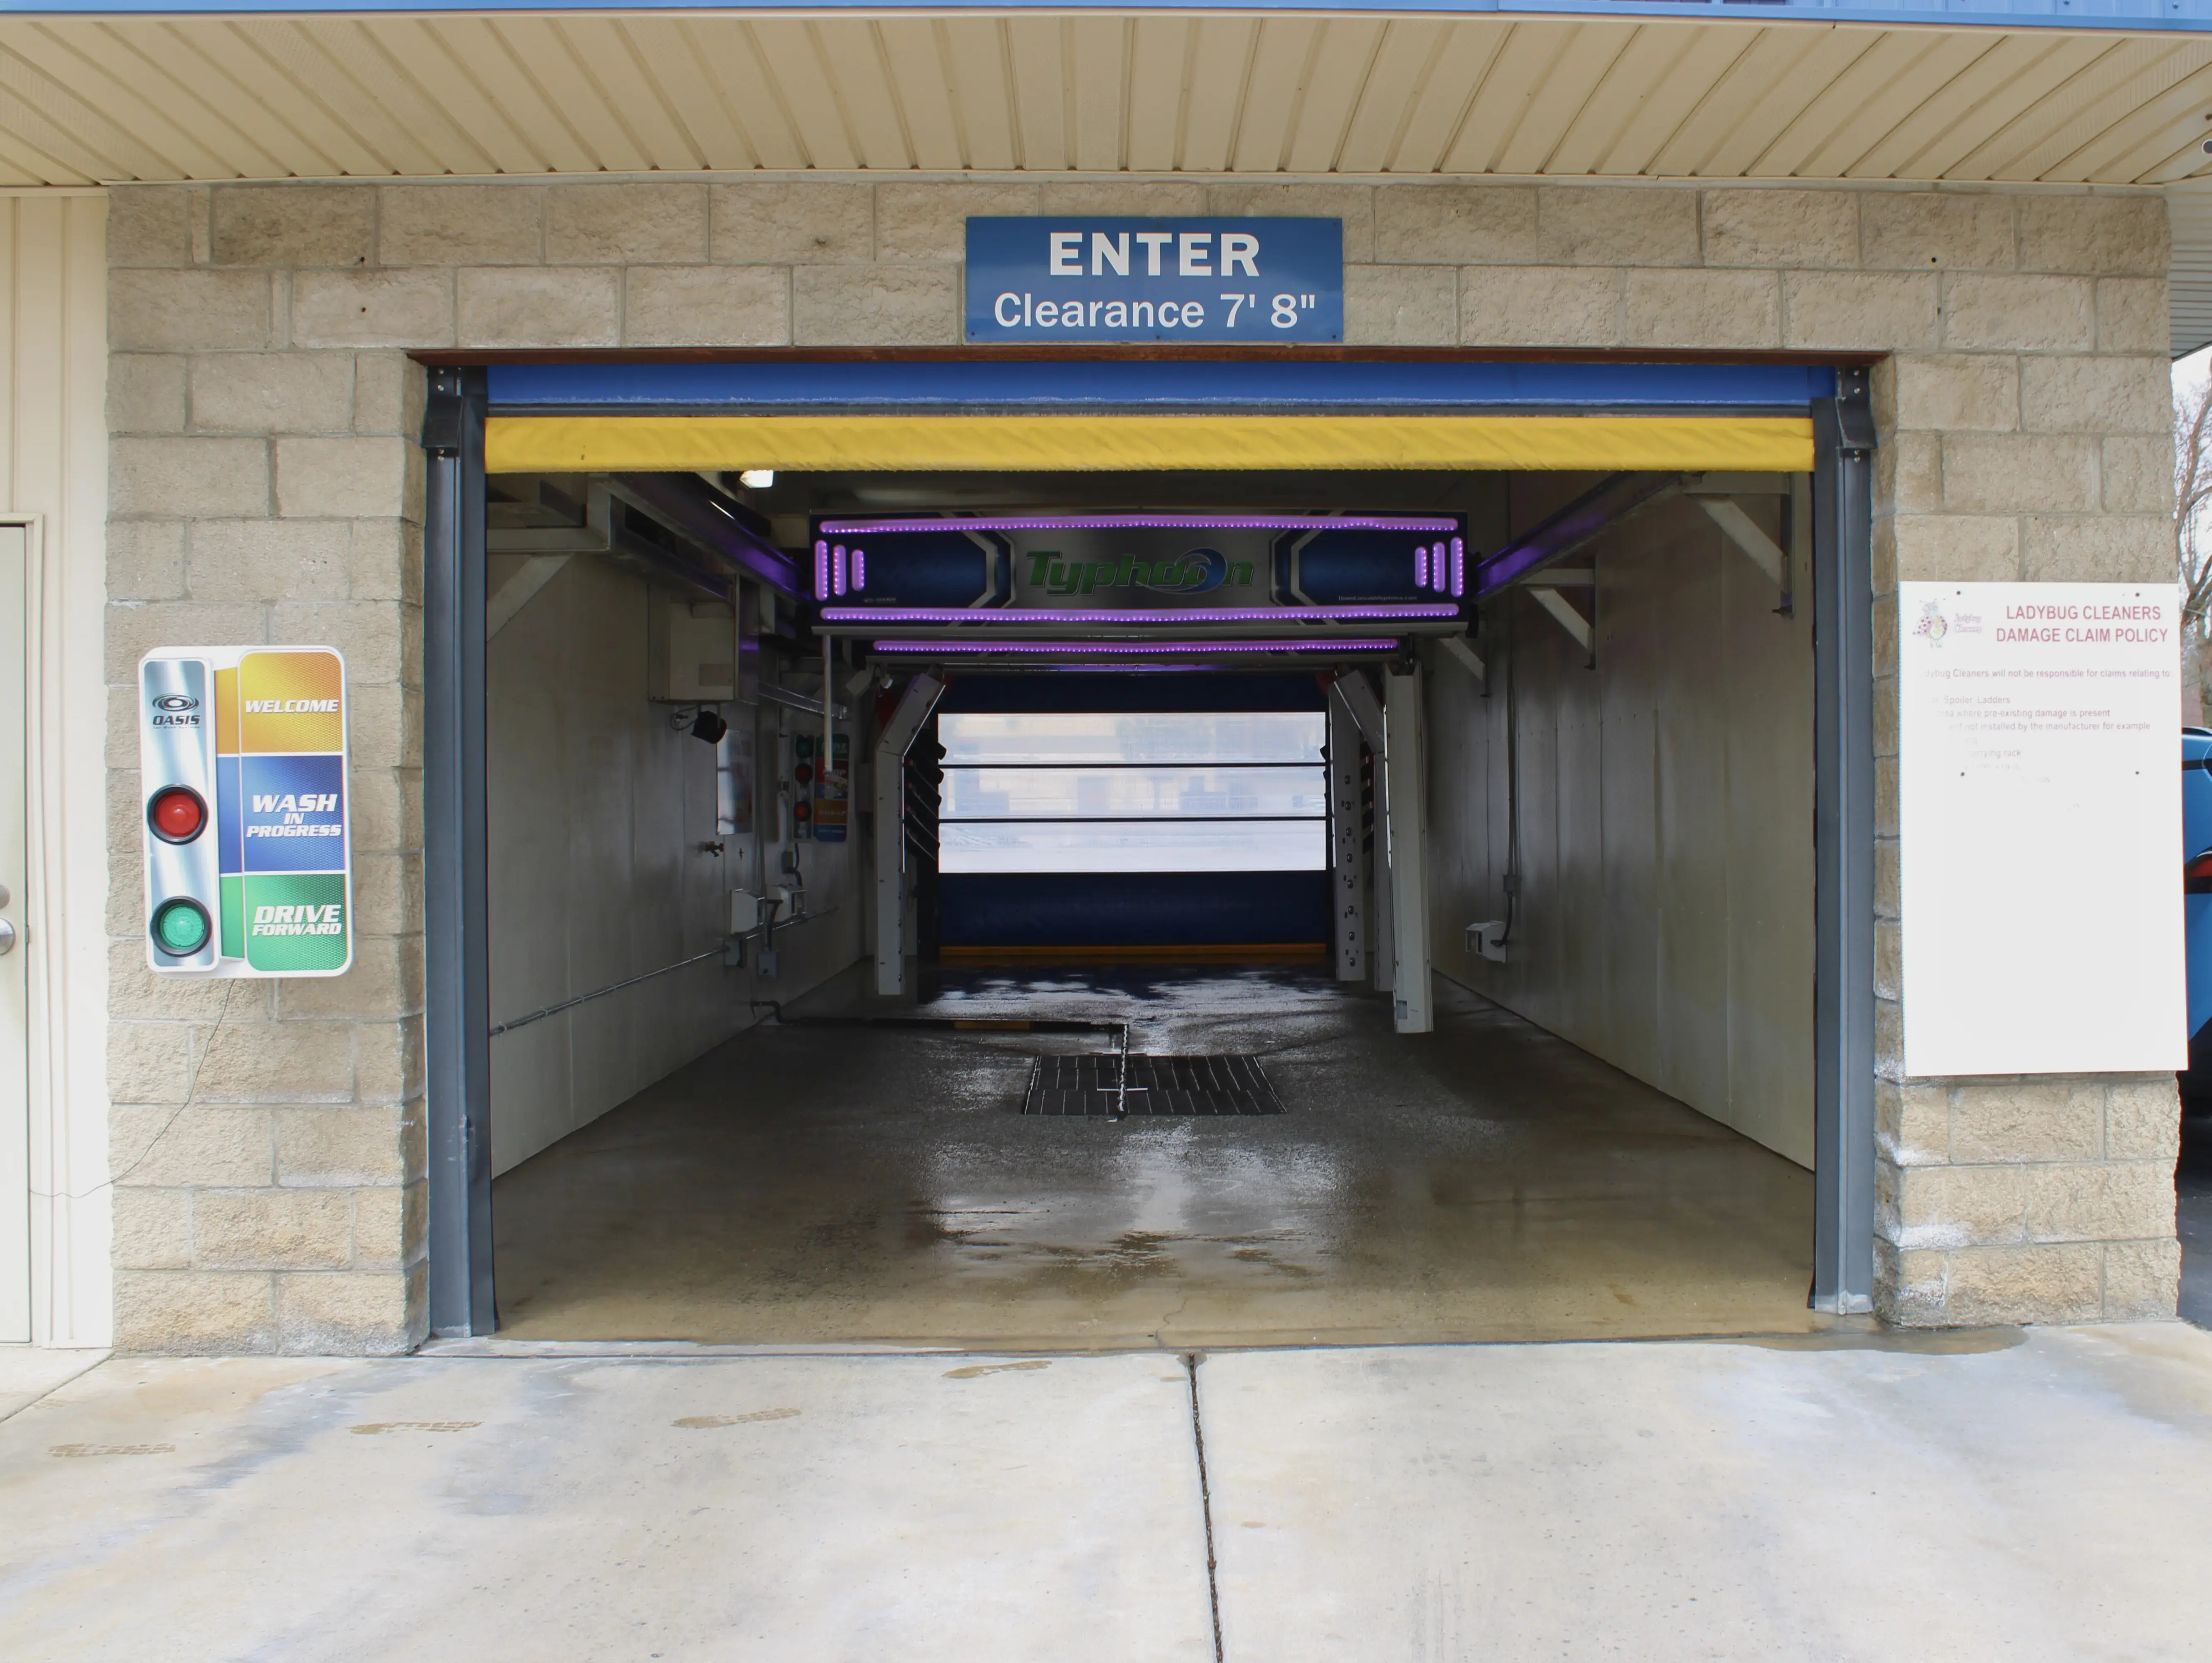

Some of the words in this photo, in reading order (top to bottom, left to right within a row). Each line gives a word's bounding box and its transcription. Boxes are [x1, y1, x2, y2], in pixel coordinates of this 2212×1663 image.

[1050, 232, 1260, 276] ENTER
[995, 293, 1204, 327] Clearance
[1220, 293, 1256, 328] 7'
[1271, 294, 1316, 328] 8"
[1026, 547, 1255, 597] Typhoon
[2006, 605, 2078, 620] LADYBUG
[2083, 606, 2161, 620] CLEANERS
[1996, 628, 2061, 642] DAMAGE
[2065, 628, 2110, 642] CLAIM
[2115, 628, 2168, 642] POLICY
[1953, 668, 1989, 677] Cleaners
[1992, 669, 2005, 677] will
[2024, 669, 2033, 677] be
[2036, 669, 2084, 679] responsible
[2100, 669, 2126, 677] claims
[2129, 669, 2160, 679] relating
[1977, 695, 2011, 704] Ladders
[246, 699, 339, 714] WELCOME
[153, 715, 201, 725] OASIS
[1957, 709, 1981, 717] where
[1984, 708, 2033, 719] pre-existing
[2035, 709, 2068, 719] damage
[2079, 709, 2110, 718] present
[1981, 722, 2015, 730] installed
[2018, 722, 2027, 732] by
[2046, 721, 2100, 730] manufacturer
[2103, 721, 2114, 730] for
[2116, 721, 2151, 731] example
[253, 793, 338, 813] WASH
[283, 812, 305, 825] IN
[246, 825, 342, 838] PROGRESS
[253, 904, 342, 925] DRIVE
[252, 923, 342, 936] FORWARD
